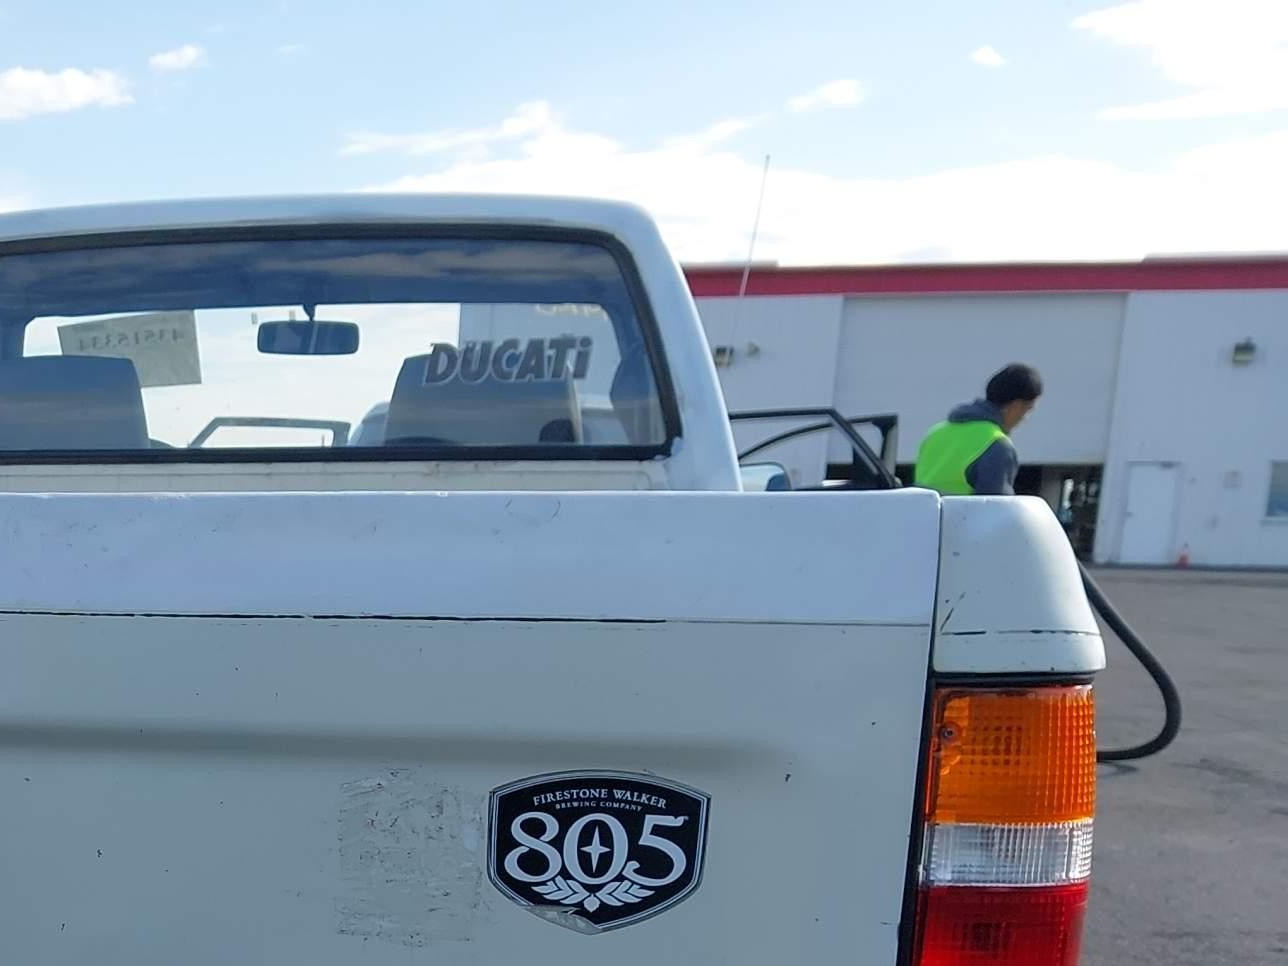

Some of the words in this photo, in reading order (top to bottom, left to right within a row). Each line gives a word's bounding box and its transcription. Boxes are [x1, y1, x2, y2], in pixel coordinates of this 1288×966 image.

[533, 788, 608, 806] FIRESTONE
[612, 788, 667, 809] WALKER
[555, 801, 597, 810] BREWING
[600, 801, 643, 812] COMPANY
[503, 811, 687, 887] 805
